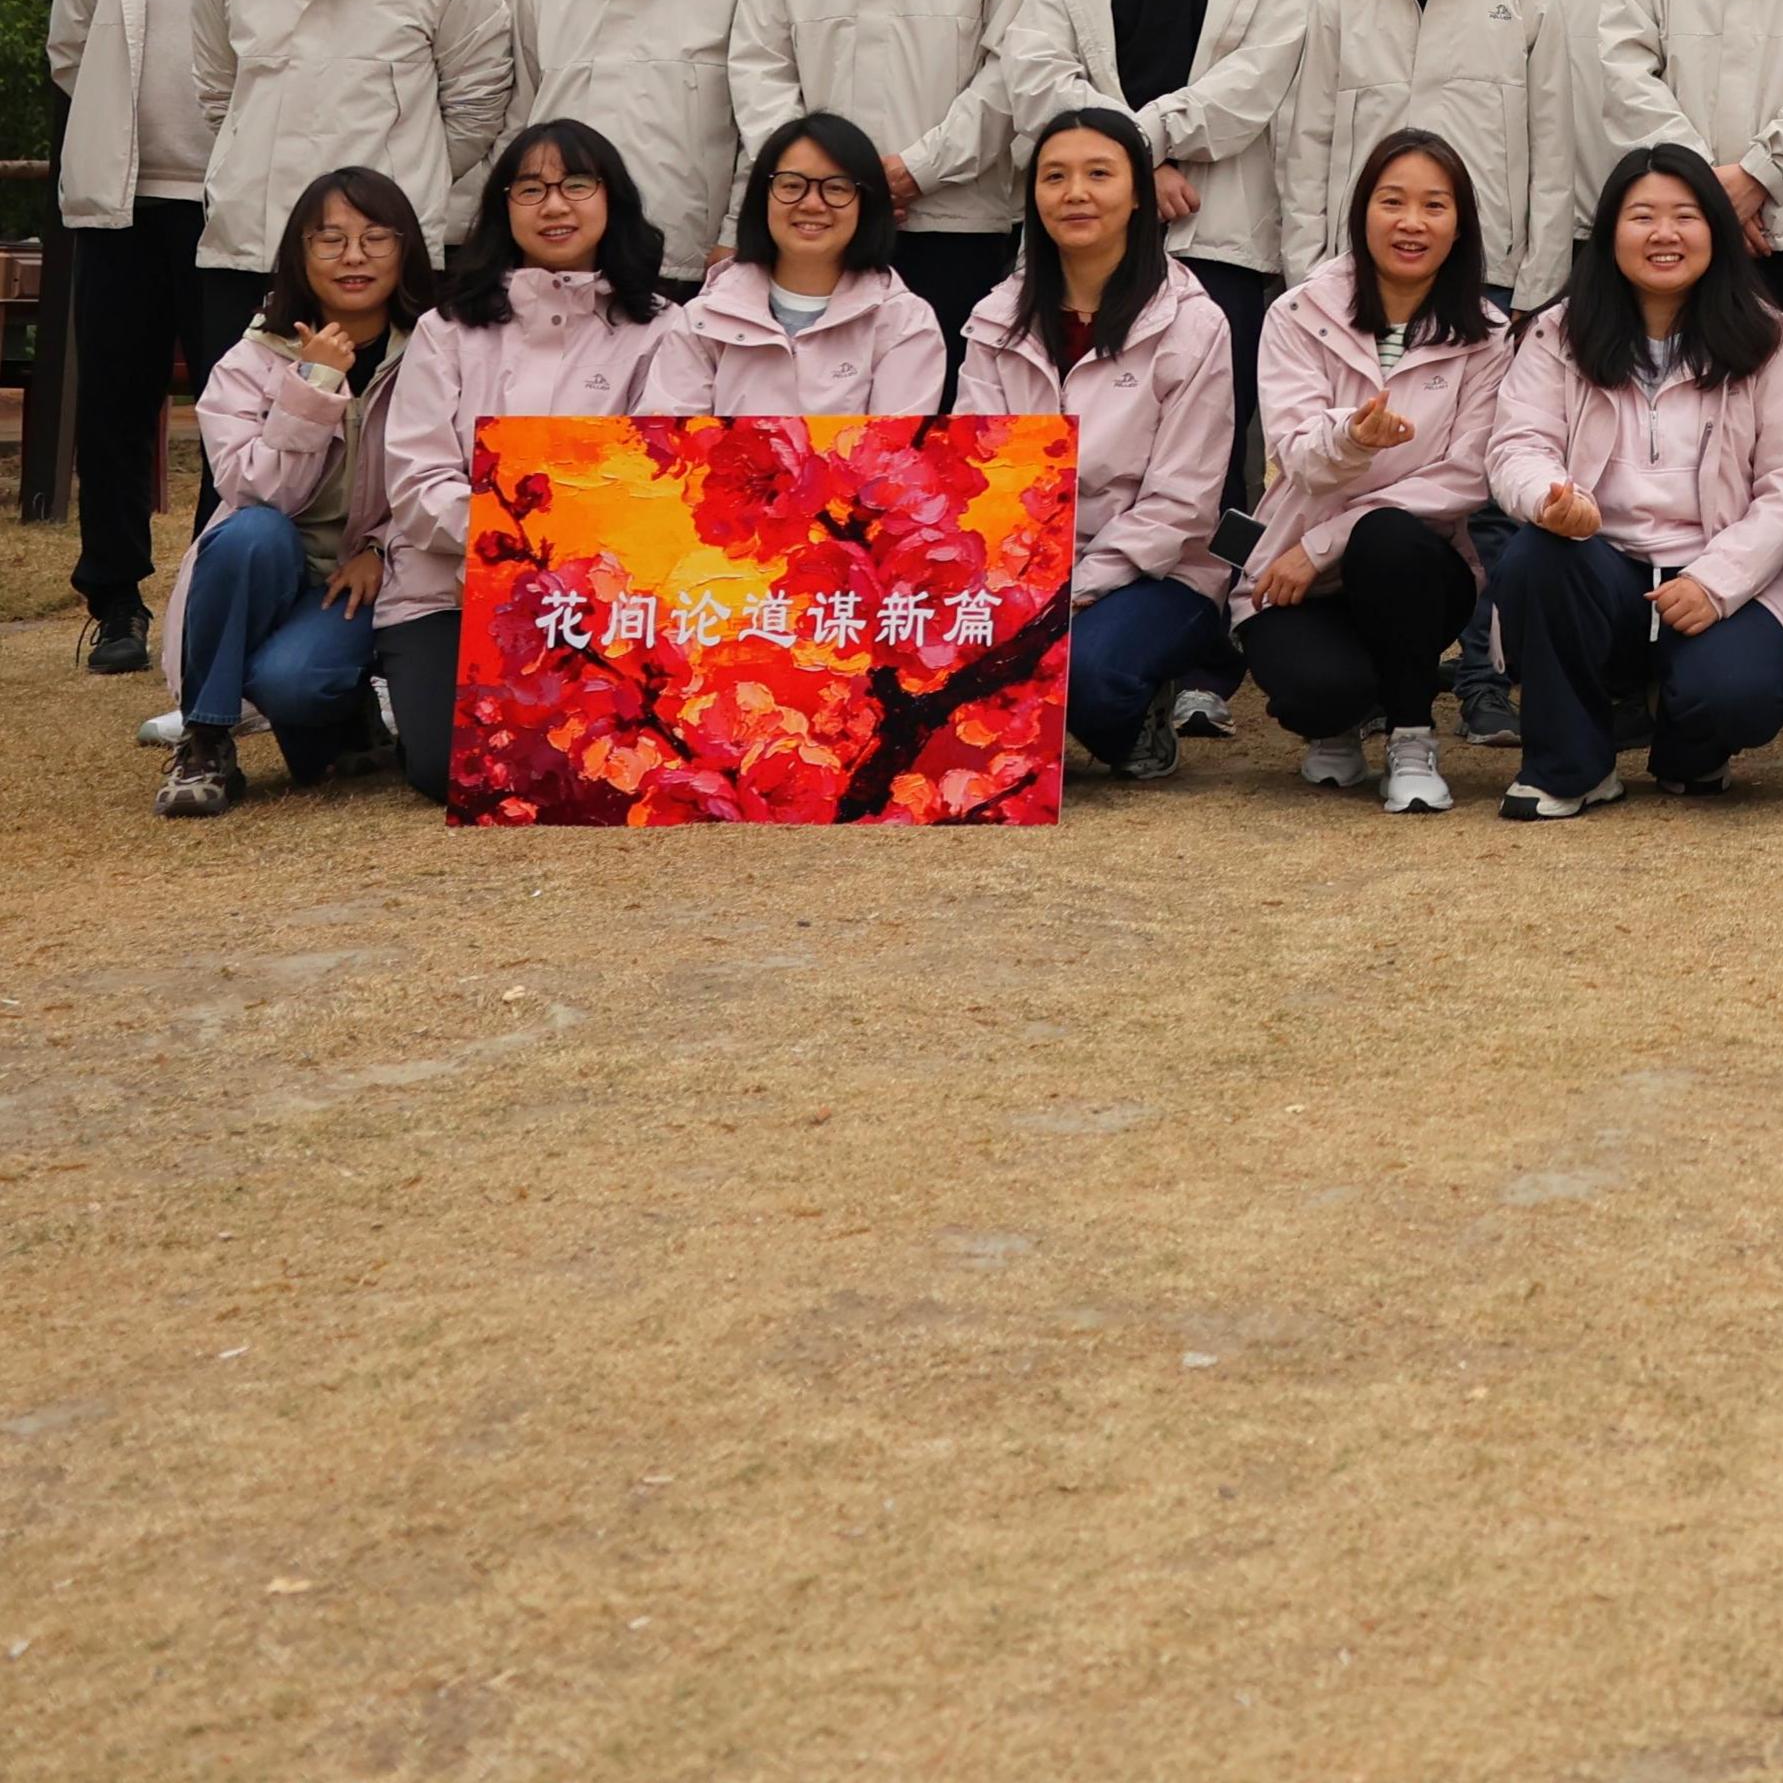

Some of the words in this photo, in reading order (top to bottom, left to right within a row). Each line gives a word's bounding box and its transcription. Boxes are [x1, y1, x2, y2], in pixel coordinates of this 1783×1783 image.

[535, 590, 1003, 649] 花间论道谋新篇
